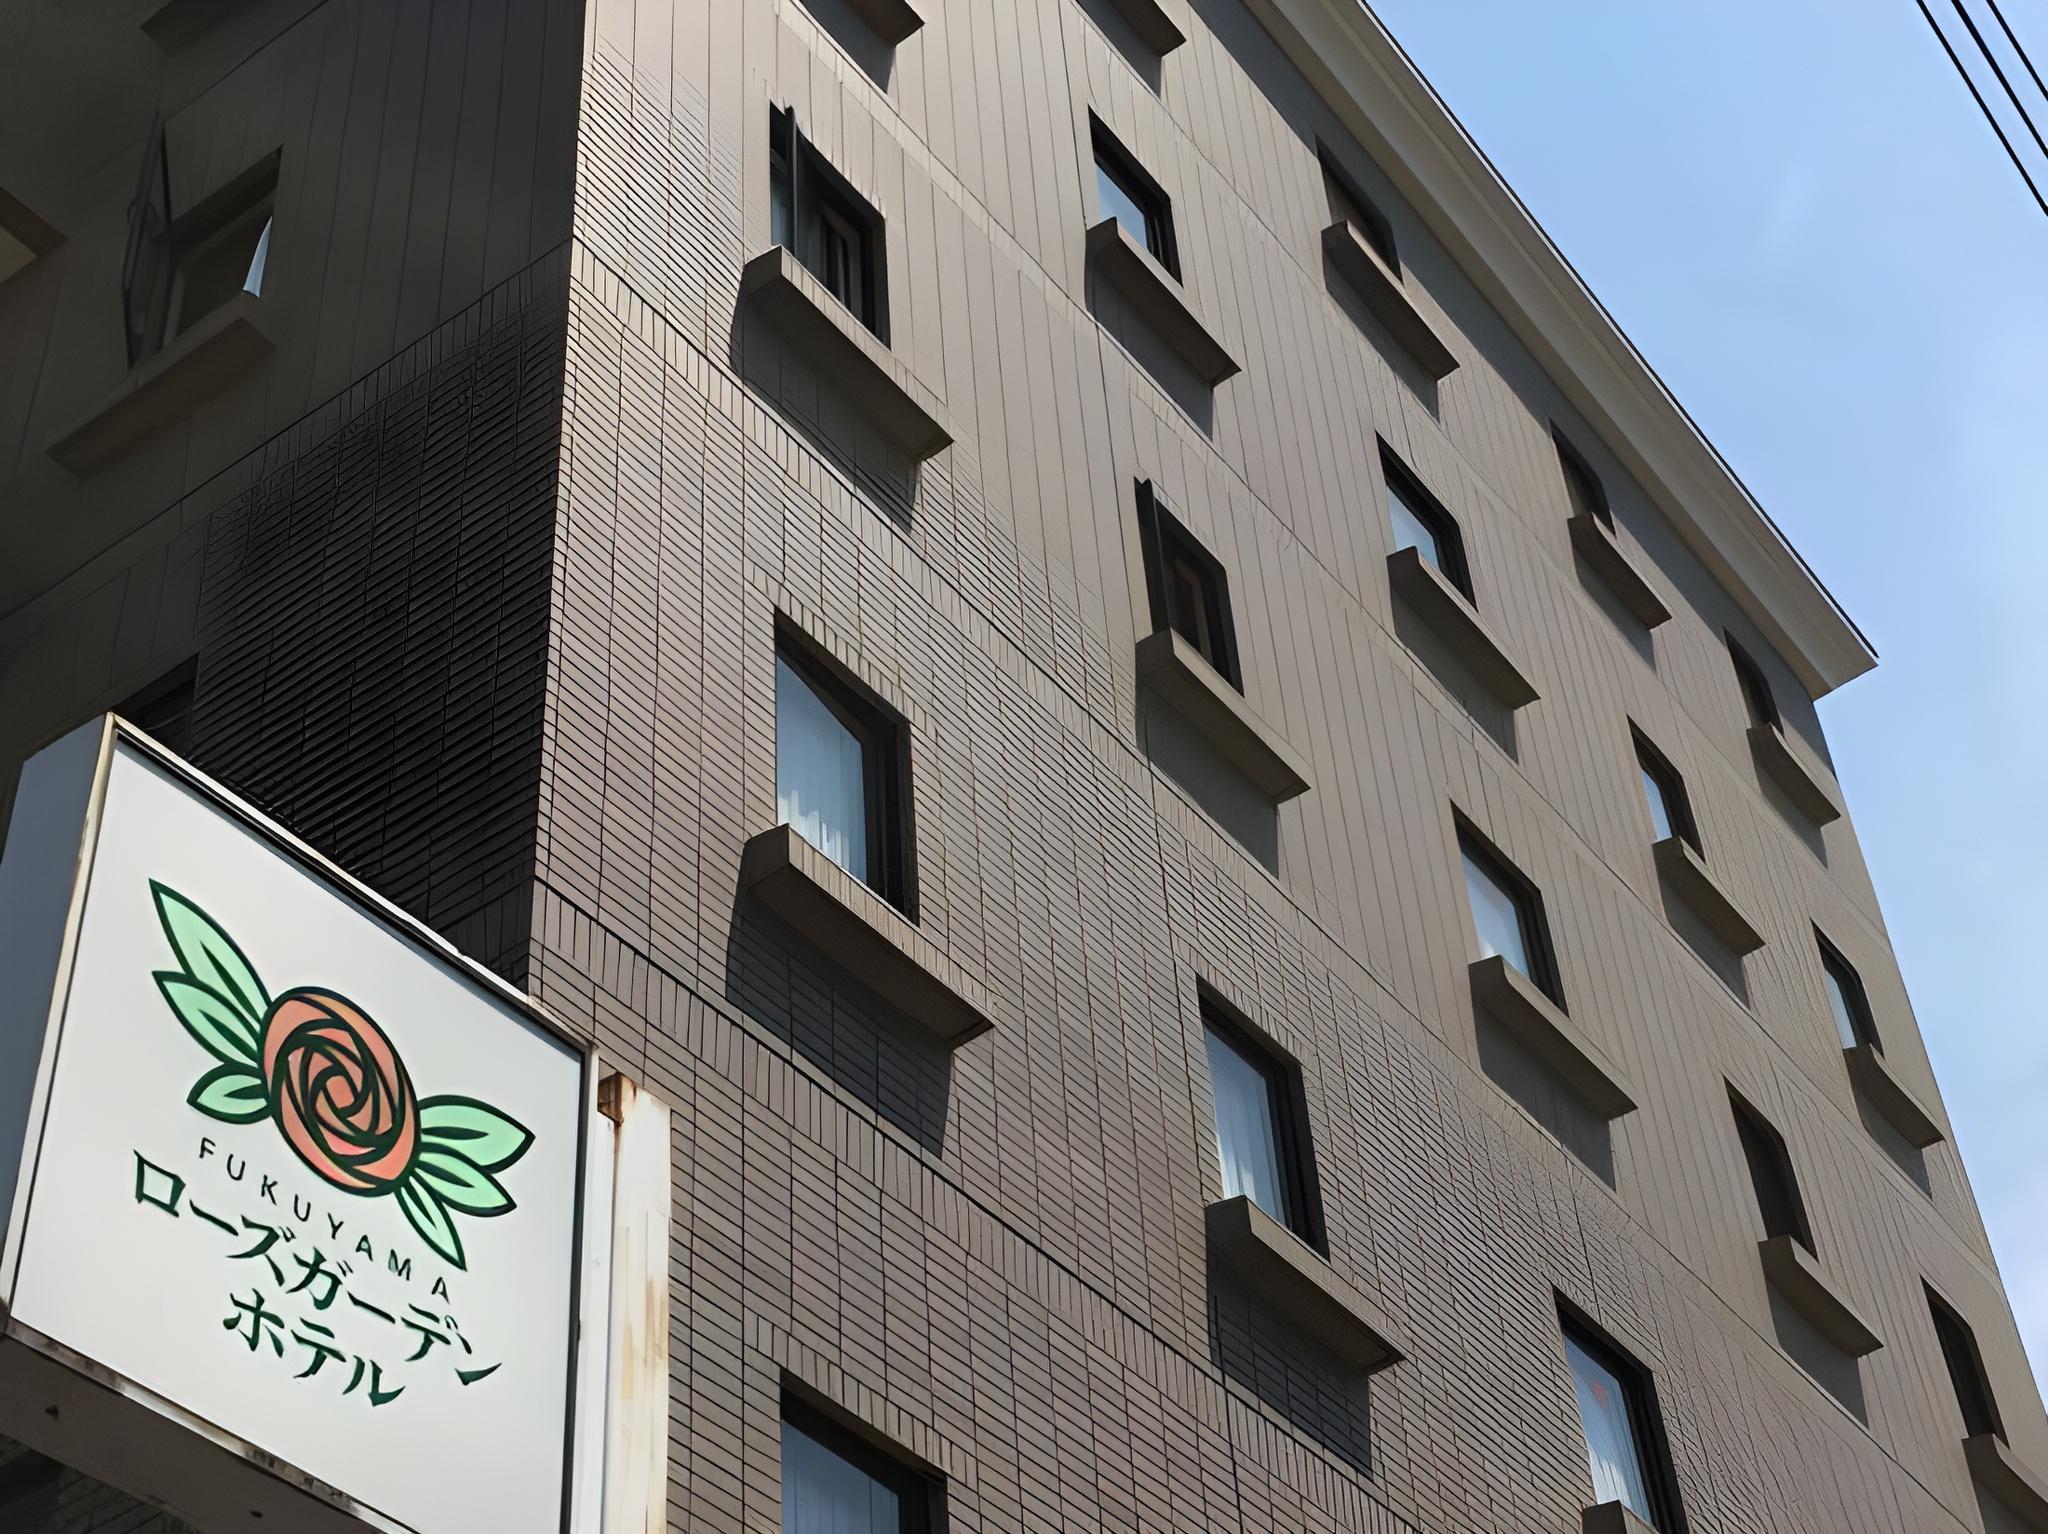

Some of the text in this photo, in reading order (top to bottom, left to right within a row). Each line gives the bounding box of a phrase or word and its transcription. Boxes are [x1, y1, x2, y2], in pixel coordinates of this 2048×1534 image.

[133, 1148, 502, 1386] ローズガーデン
[198, 1136, 450, 1304] FUKUYAMA
[222, 1287, 406, 1408] ホテル
